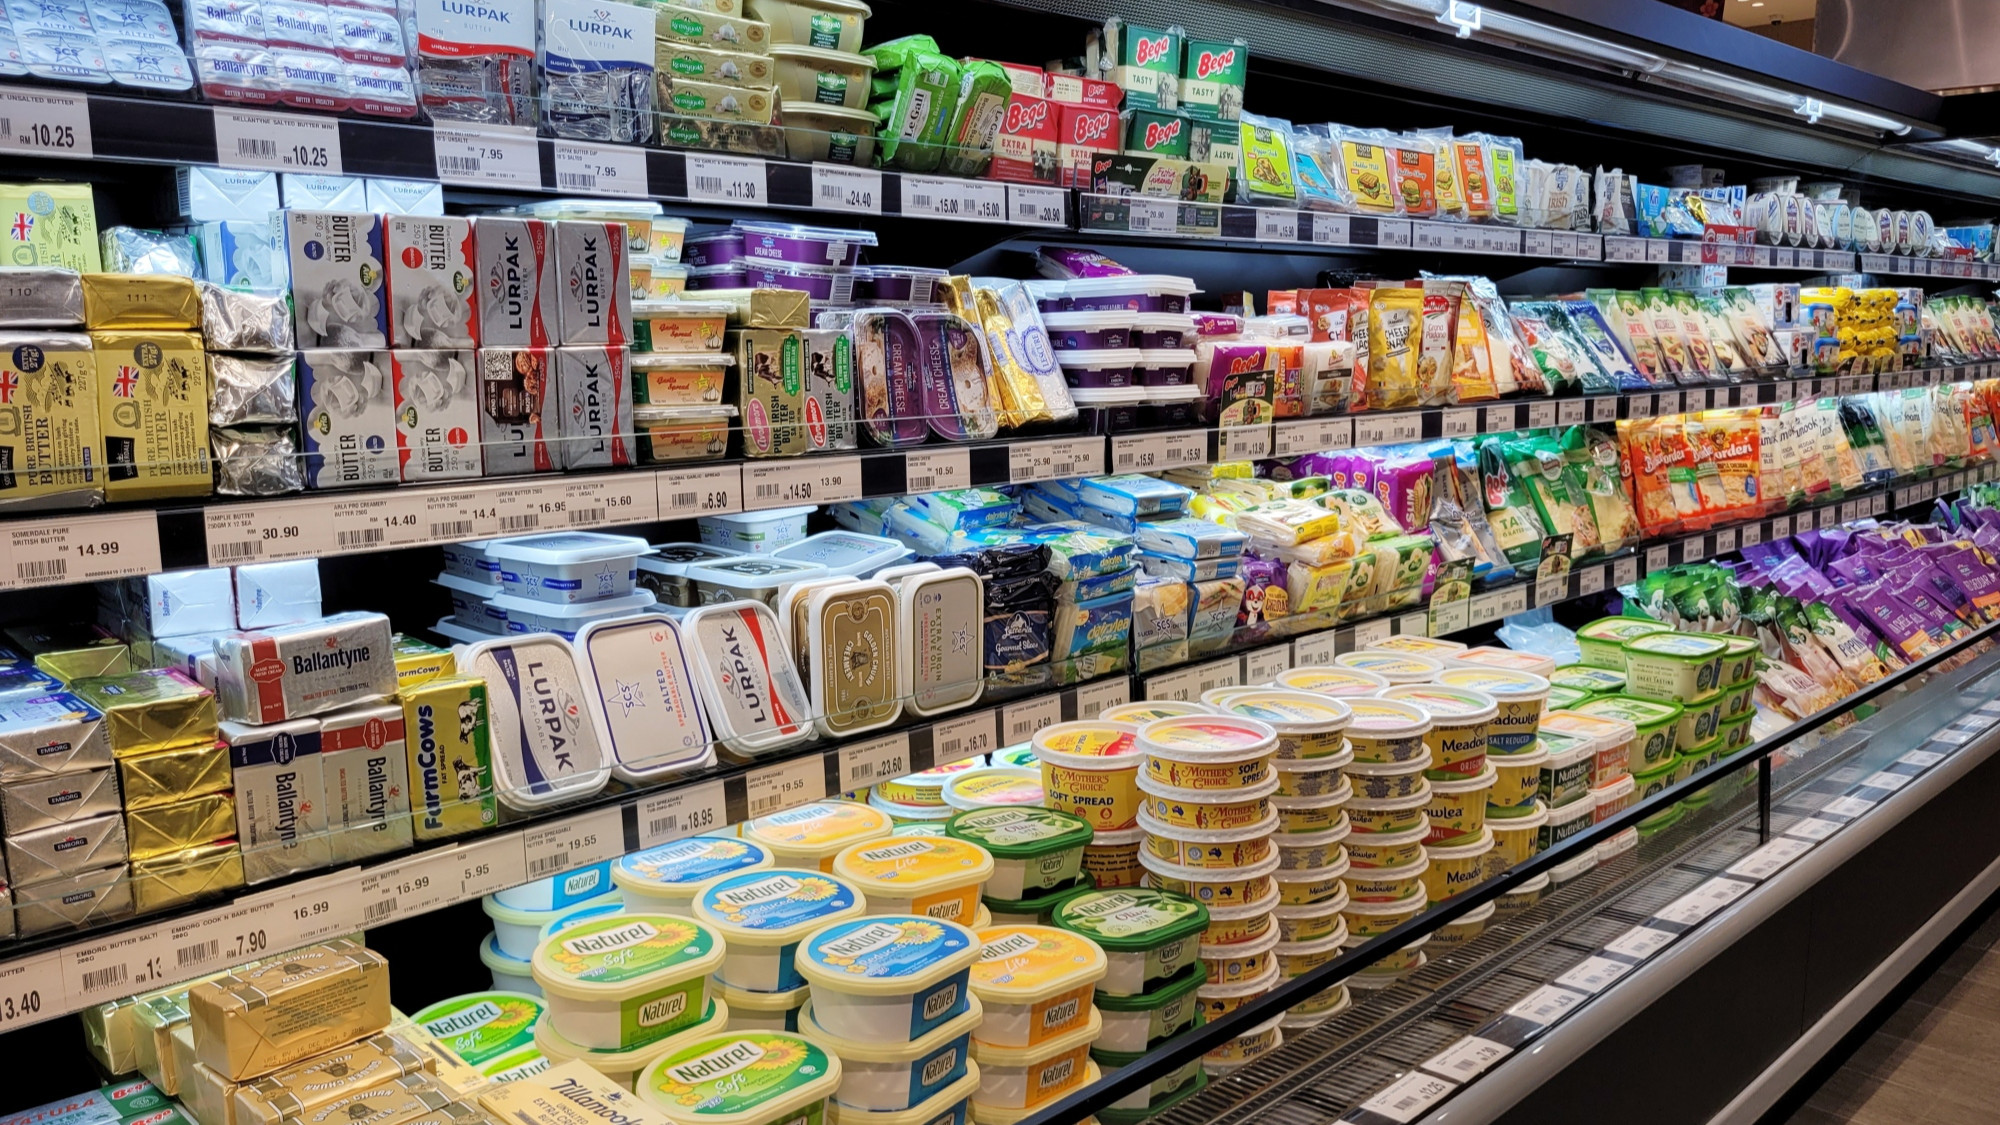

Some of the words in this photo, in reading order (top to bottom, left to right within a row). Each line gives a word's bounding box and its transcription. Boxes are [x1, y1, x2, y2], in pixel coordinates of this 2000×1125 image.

[207, 6, 262, 26] Ballantyne
[442, 0, 512, 24] LURPAK
[277, 15, 329, 34] Ballantyne
[343, 24, 393, 42] Ballantyne
[570, 19, 633, 40] LURPAK
[1135, 36, 1170, 66] Bega
[214, 58, 268, 76] Ballantyne
[1197, 49, 1235, 79] Bega
[284, 66, 337, 84] Ballantyne
[354, 75, 404, 92] Ballantyne
[1132, 73, 1153, 85] TASTY
[1192, 88, 1215, 97] TASTY
[1006, 101, 1047, 134] Bega
[19, 135, 31, 145] RM
[31, 123, 75, 148] 10.25
[1075, 111, 1110, 144] Bega
[1145, 119, 1181, 149] Bega
[1001, 138, 1027, 150] EXTRA
[283, 156, 293, 165] RM
[293, 146, 328, 167] 10.25
[306, 184, 341, 192] LURPAK
[732, 181, 756, 199] 11.30
[940, 199, 958, 215] 15.00
[982, 201, 1000, 217] 15.00
[332, 215, 352, 263] BUTTER
[429, 225, 445, 270] BUTTER
[361, 265, 372, 286] Arla
[509, 236, 522, 329] LURPAK
[586, 237, 600, 327] LURPAK
[893, 344, 903, 379] CREAM
[895, 380, 906, 413] CHEESE
[937, 380, 950, 410] CREAM
[407, 407, 418, 428] Arla
[591, 364, 607, 453] LURPAK
[319, 413, 331, 434] Arla
[36, 417, 53, 486] BUTTER
[155, 411, 172, 477] BUTTER
[429, 427, 444, 474] BUTTER
[1714, 443, 1753, 461] orden
[344, 434, 359, 481] BUTTER
[1033, 456, 1050, 467] 25.90
[1074, 453, 1089, 462] 25.90
[1139, 452, 1154, 467] 15.50
[934, 465, 954, 476] 10.50
[821, 476, 842, 487] 13.90
[539, 501, 566, 513] 16.95
[707, 490, 728, 509] 6.90
[1406, 488, 1416, 522] SLIM
[233, 512, 255, 520] BUTTER
[384, 515, 417, 528] 14.40
[12, 529, 50, 538] SOMERDALE
[52, 528, 70, 536] PURE
[12, 538, 38, 546] BRITISH
[40, 536, 66, 544] BUTTER
[262, 526, 299, 540] 30.90
[77, 541, 119, 557] 14.99
[599, 573, 614, 582] SCS
[1211, 611, 1226, 621] SCS
[293, 646, 370, 675] Ballantyne
[843, 640, 854, 683] CREAMERY
[721, 624, 767, 723] LURPAK
[742, 645, 767, 702] SPREADABLE
[621, 684, 634, 709] SCS
[656, 668, 673, 713] SALTED
[527, 662, 575, 772] LURPAK
[40, 744, 69, 754] EMBORG
[968, 733, 988, 750] 16.70
[1489, 737, 1506, 745] SALT
[1507, 735, 1530, 745] REDUCED
[418, 704, 443, 831] FarmCows
[881, 756, 902, 776] 23.60
[1181, 764, 1234, 778] MOTHER'S
[1238, 761, 1260, 775] SOFT
[1558, 763, 1588, 782] Nuttelex
[1059, 770, 1109, 785] MOTHER'S
[51, 793, 79, 803] EMBORG
[1050, 789, 1068, 802] SOFT
[1073, 796, 1114, 806] SPREAD
[688, 808, 713, 830] 18.95
[774, 804, 833, 826] Naturel
[974, 812, 1023, 828] Naturel
[1557, 822, 1586, 839] Nuttelex
[57, 838, 85, 850] EMBORG
[568, 834, 597, 850] 19.55
[865, 841, 928, 862] Naturel
[644, 842, 706, 866] Naturel
[464, 863, 490, 880] 5.95
[895, 857, 919, 871] Lite
[1042, 857, 1062, 872] Naturel
[380, 869, 400, 880] BUTTER
[396, 876, 430, 895] 16.99
[567, 876, 598, 893] Naturel
[725, 877, 793, 905] Naturel
[65, 892, 93, 903] EMBORG
[1082, 895, 1135, 916] Naturel
[171, 921, 200, 933] EMBORG
[202, 915, 222, 926] COOK
[231, 908, 248, 920] BAKE
[249, 902, 275, 914] BUTTER
[293, 901, 330, 920] 16.99
[928, 901, 961, 919] Naturel
[226, 949, 237, 959] RM
[236, 929, 267, 956] 7.90
[571, 923, 655, 955] Naturel
[831, 924, 898, 956] Naturel
[603, 949, 634, 968] Soft
[1161, 943, 1181, 959] Naturel
[1005, 956, 1030, 973] Lite
[136, 974, 147, 984] RM
[642, 995, 683, 1026] Naturel
[926, 984, 955, 1018] Naturel
[427, 1004, 498, 1039] Naturel
[1045, 1000, 1078, 1025] Naturel
[456, 1030, 482, 1051] Soft
[675, 1041, 760, 1083] Naturel
[923, 1050, 954, 1084] Naturel
[1041, 1060, 1072, 1084] Naturel
[715, 1072, 746, 1095] Soft
